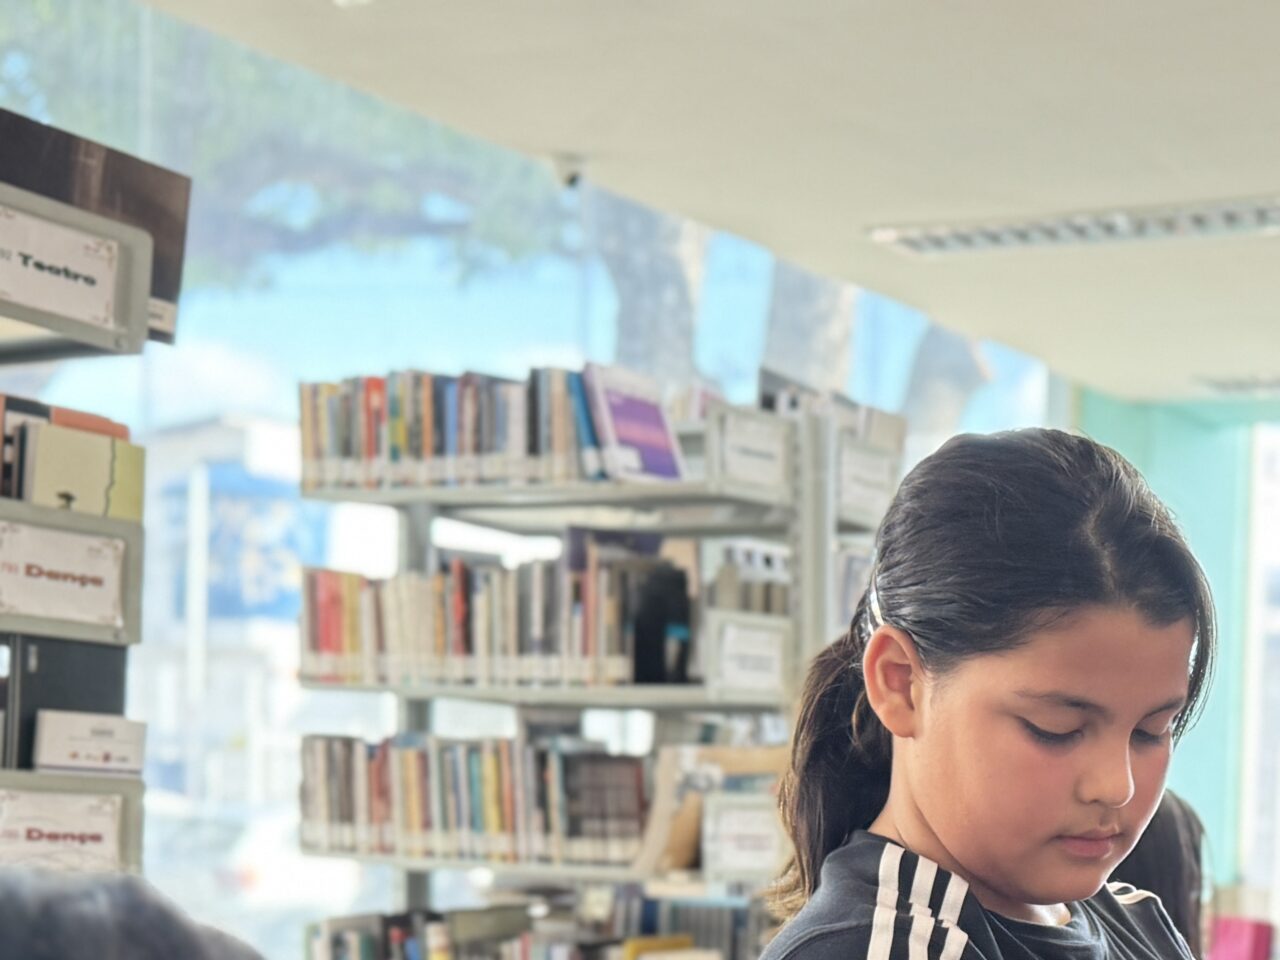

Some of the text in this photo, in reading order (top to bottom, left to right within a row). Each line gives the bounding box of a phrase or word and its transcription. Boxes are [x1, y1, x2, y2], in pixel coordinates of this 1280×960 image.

[18, 252, 97, 287] Teatro
[25, 562, 104, 588] Dança
[25, 827, 103, 844] Dança
